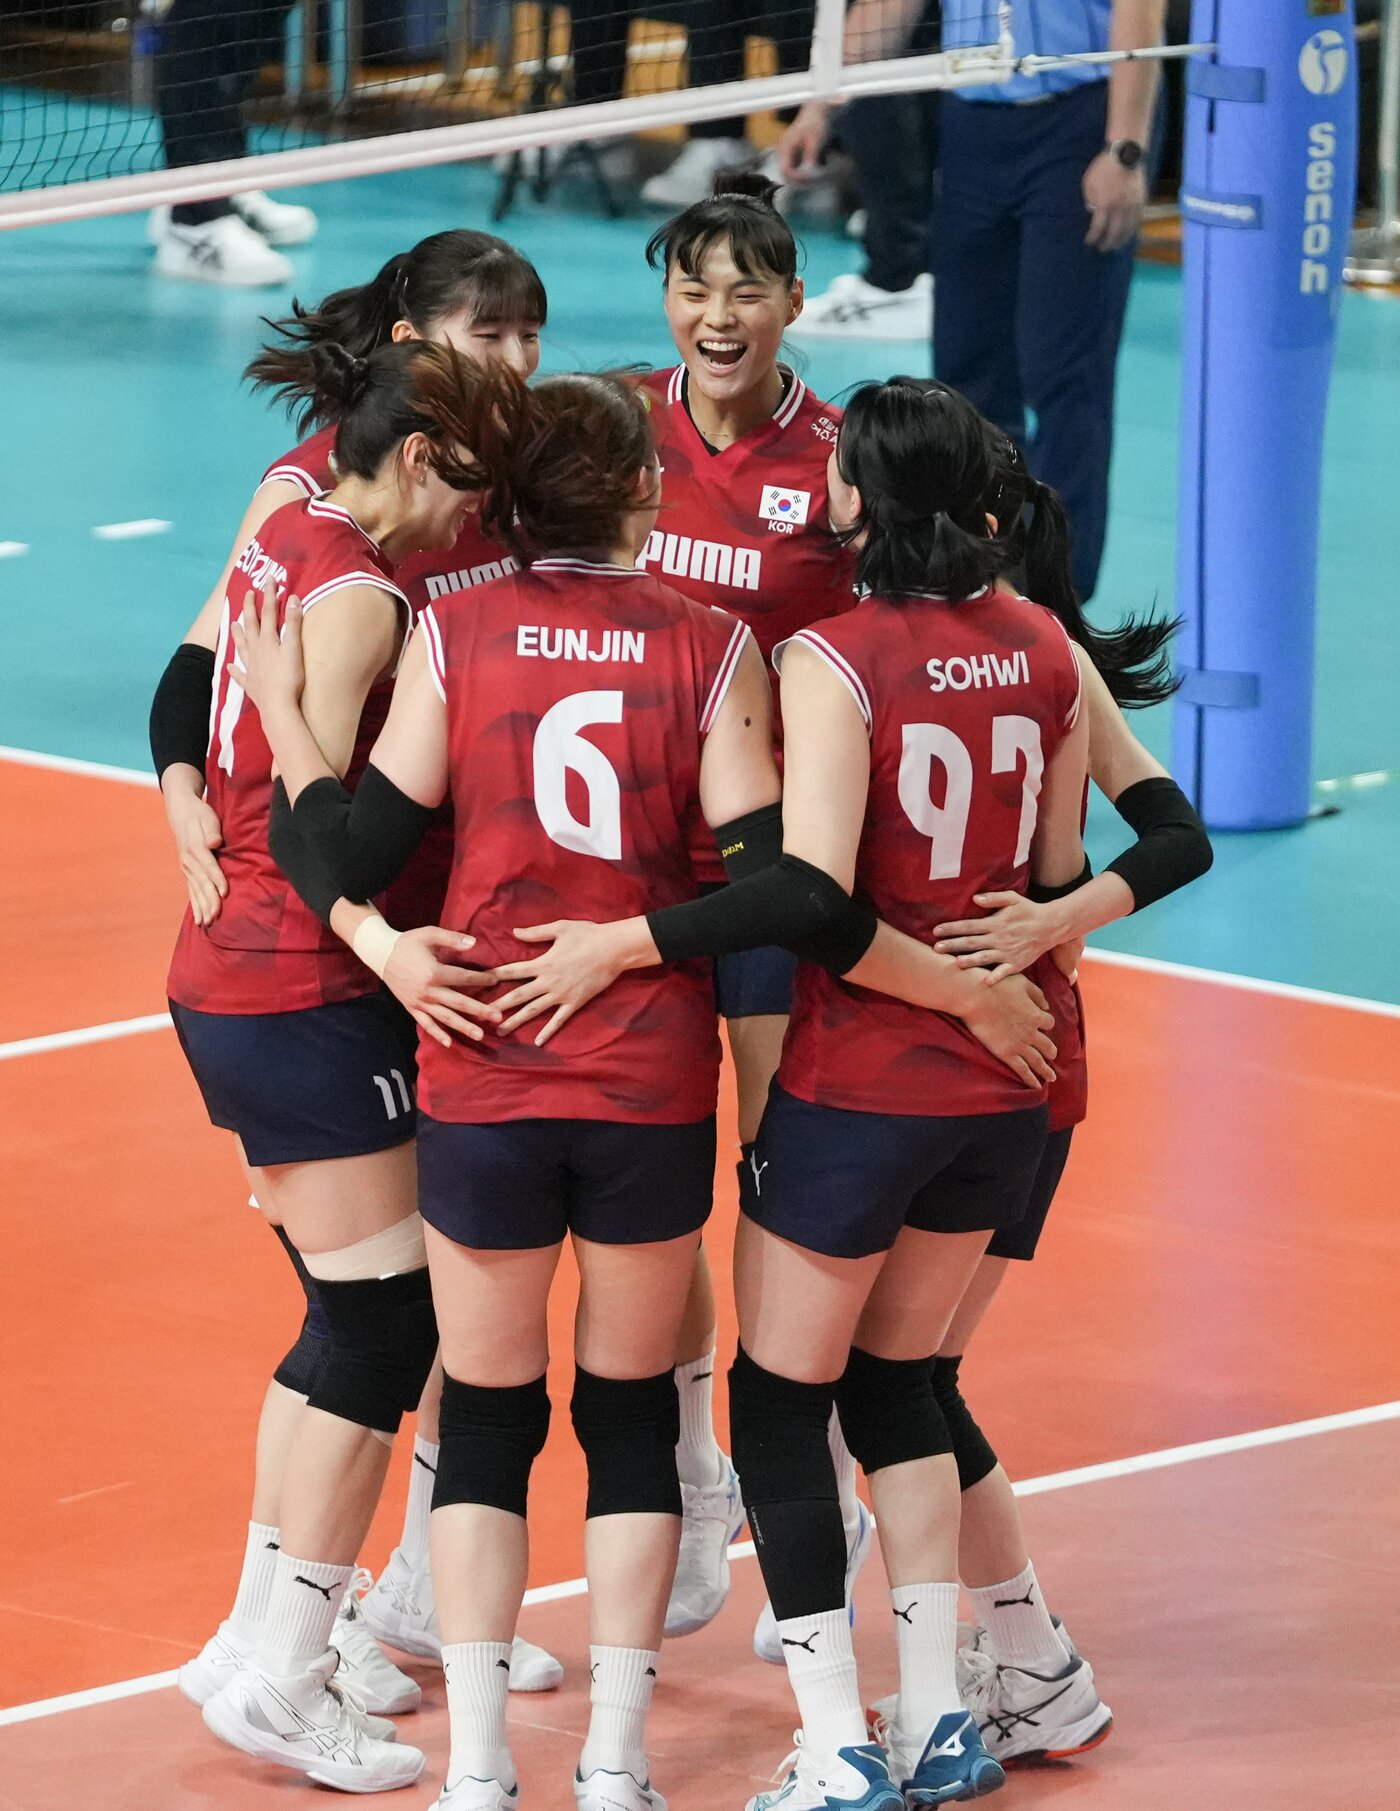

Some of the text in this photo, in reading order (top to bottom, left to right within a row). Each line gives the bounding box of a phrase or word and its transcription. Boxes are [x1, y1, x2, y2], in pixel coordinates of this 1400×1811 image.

[768, 520, 795, 534] KOR
[634, 530, 762, 591] PUMA
[516, 625, 646, 664] EUNJIN
[926, 651, 1030, 692] SOHWI
[532, 690, 624, 861] 6
[897, 714, 1045, 881] 97
[373, 1069, 412, 1120] 11
